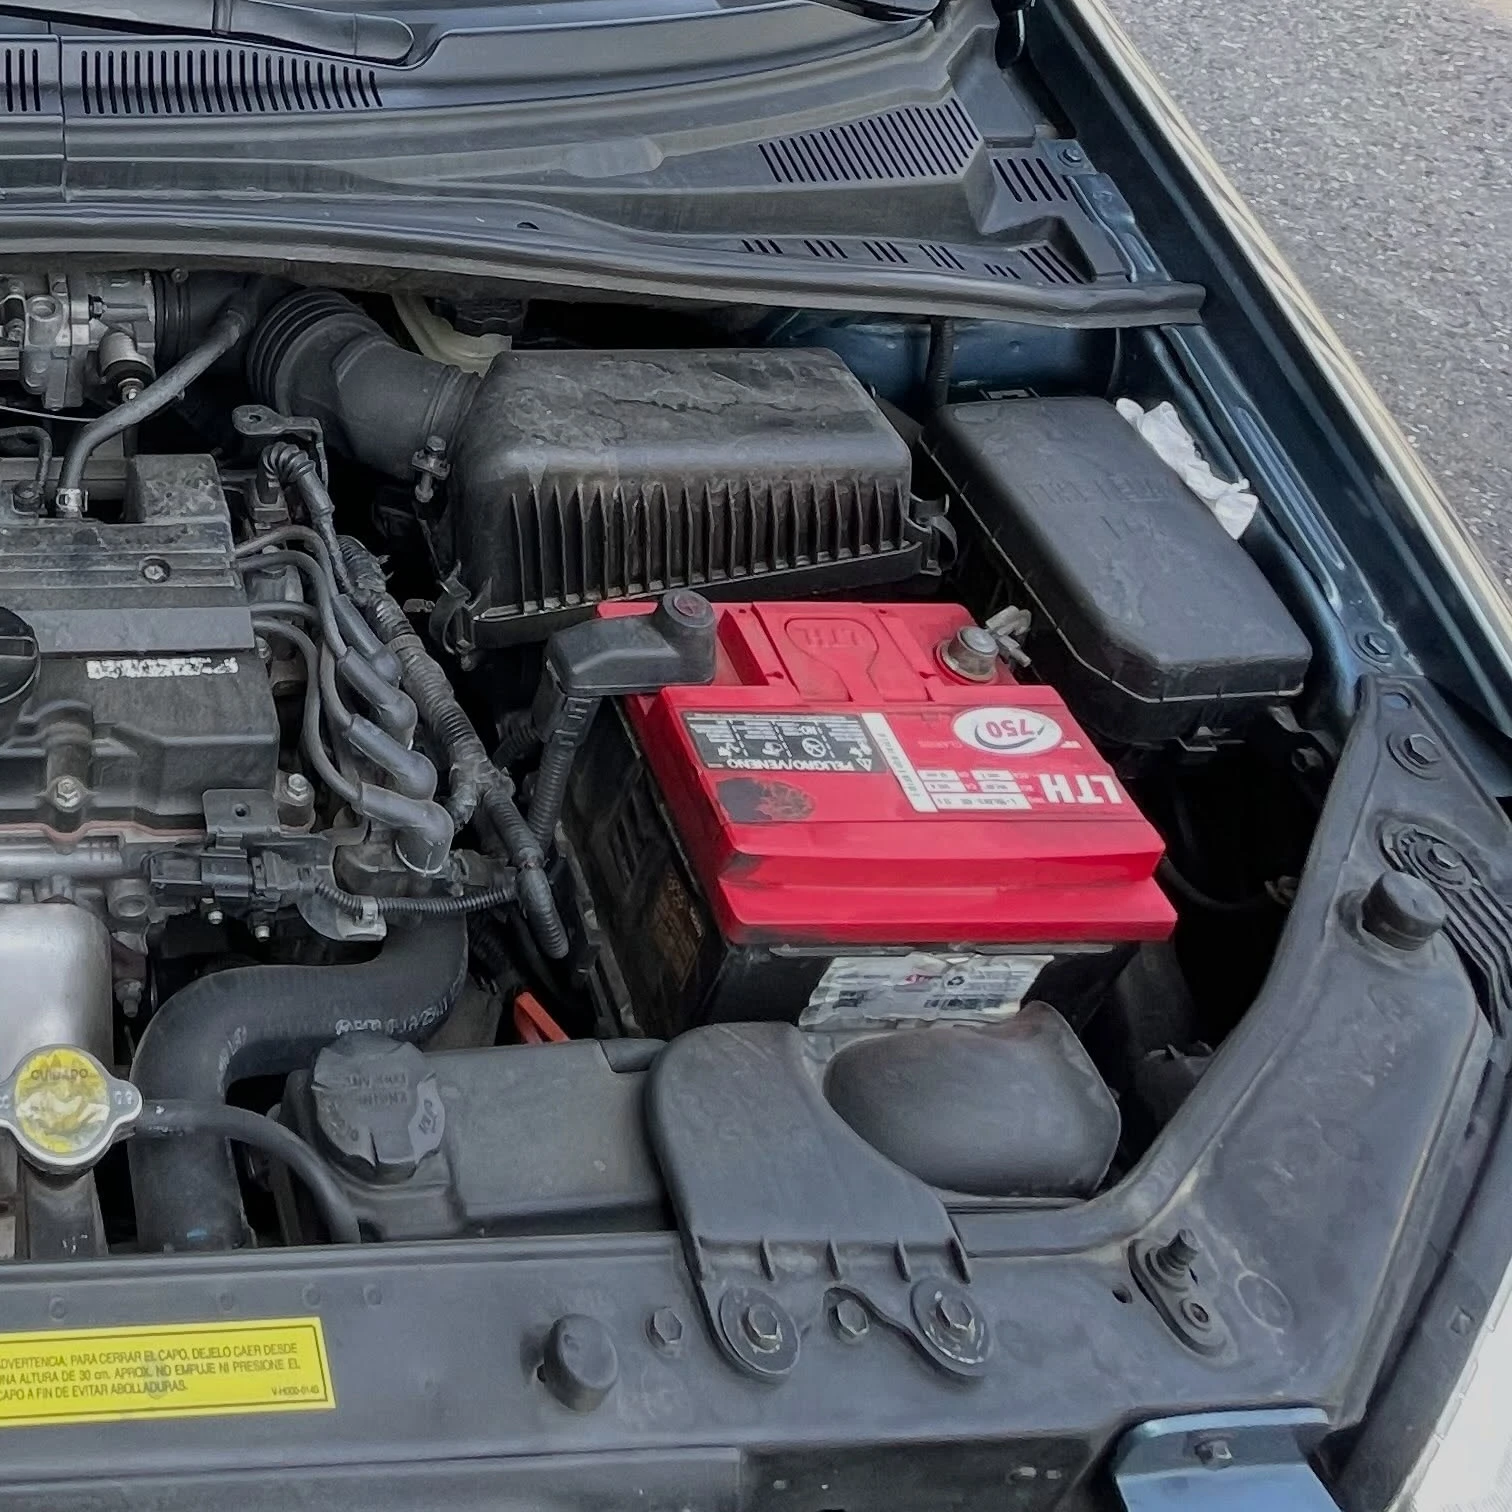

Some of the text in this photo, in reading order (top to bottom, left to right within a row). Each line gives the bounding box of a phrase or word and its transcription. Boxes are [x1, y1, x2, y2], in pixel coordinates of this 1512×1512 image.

[987, 718, 1034, 738] 750
[726, 758, 856, 771] PELIGRO/VENENO
[1039, 774, 1123, 804] LTH
[31, 1068, 88, 1081] CUIDADO
[70, 1353, 98, 1365] PARA
[99, 1351, 142, 1364] CERRAR
[144, 1350, 156, 1361] EL
[192, 1346, 232, 1360] DEJELO
[233, 1344, 262, 1357] CAER
[263, 1343, 297, 1356] DESDE
[19, 1371, 59, 1384] ALTURA
[61, 1370, 75, 1382] DE
[79, 1369, 90, 1381] 30
[155, 1365, 171, 1377] NO
[175, 1362, 216, 1376] EMPUJE
[219, 1361, 230, 1373] NI
[233, 1358, 284, 1373] PRESIONE
[288, 1357, 301, 1370] EL
[27, 1388, 36, 1400] A
[37, 1387, 53, 1399] FIN
[55, 1386, 70, 1398] DE
[72, 1384, 108, 1397] EVITAR
